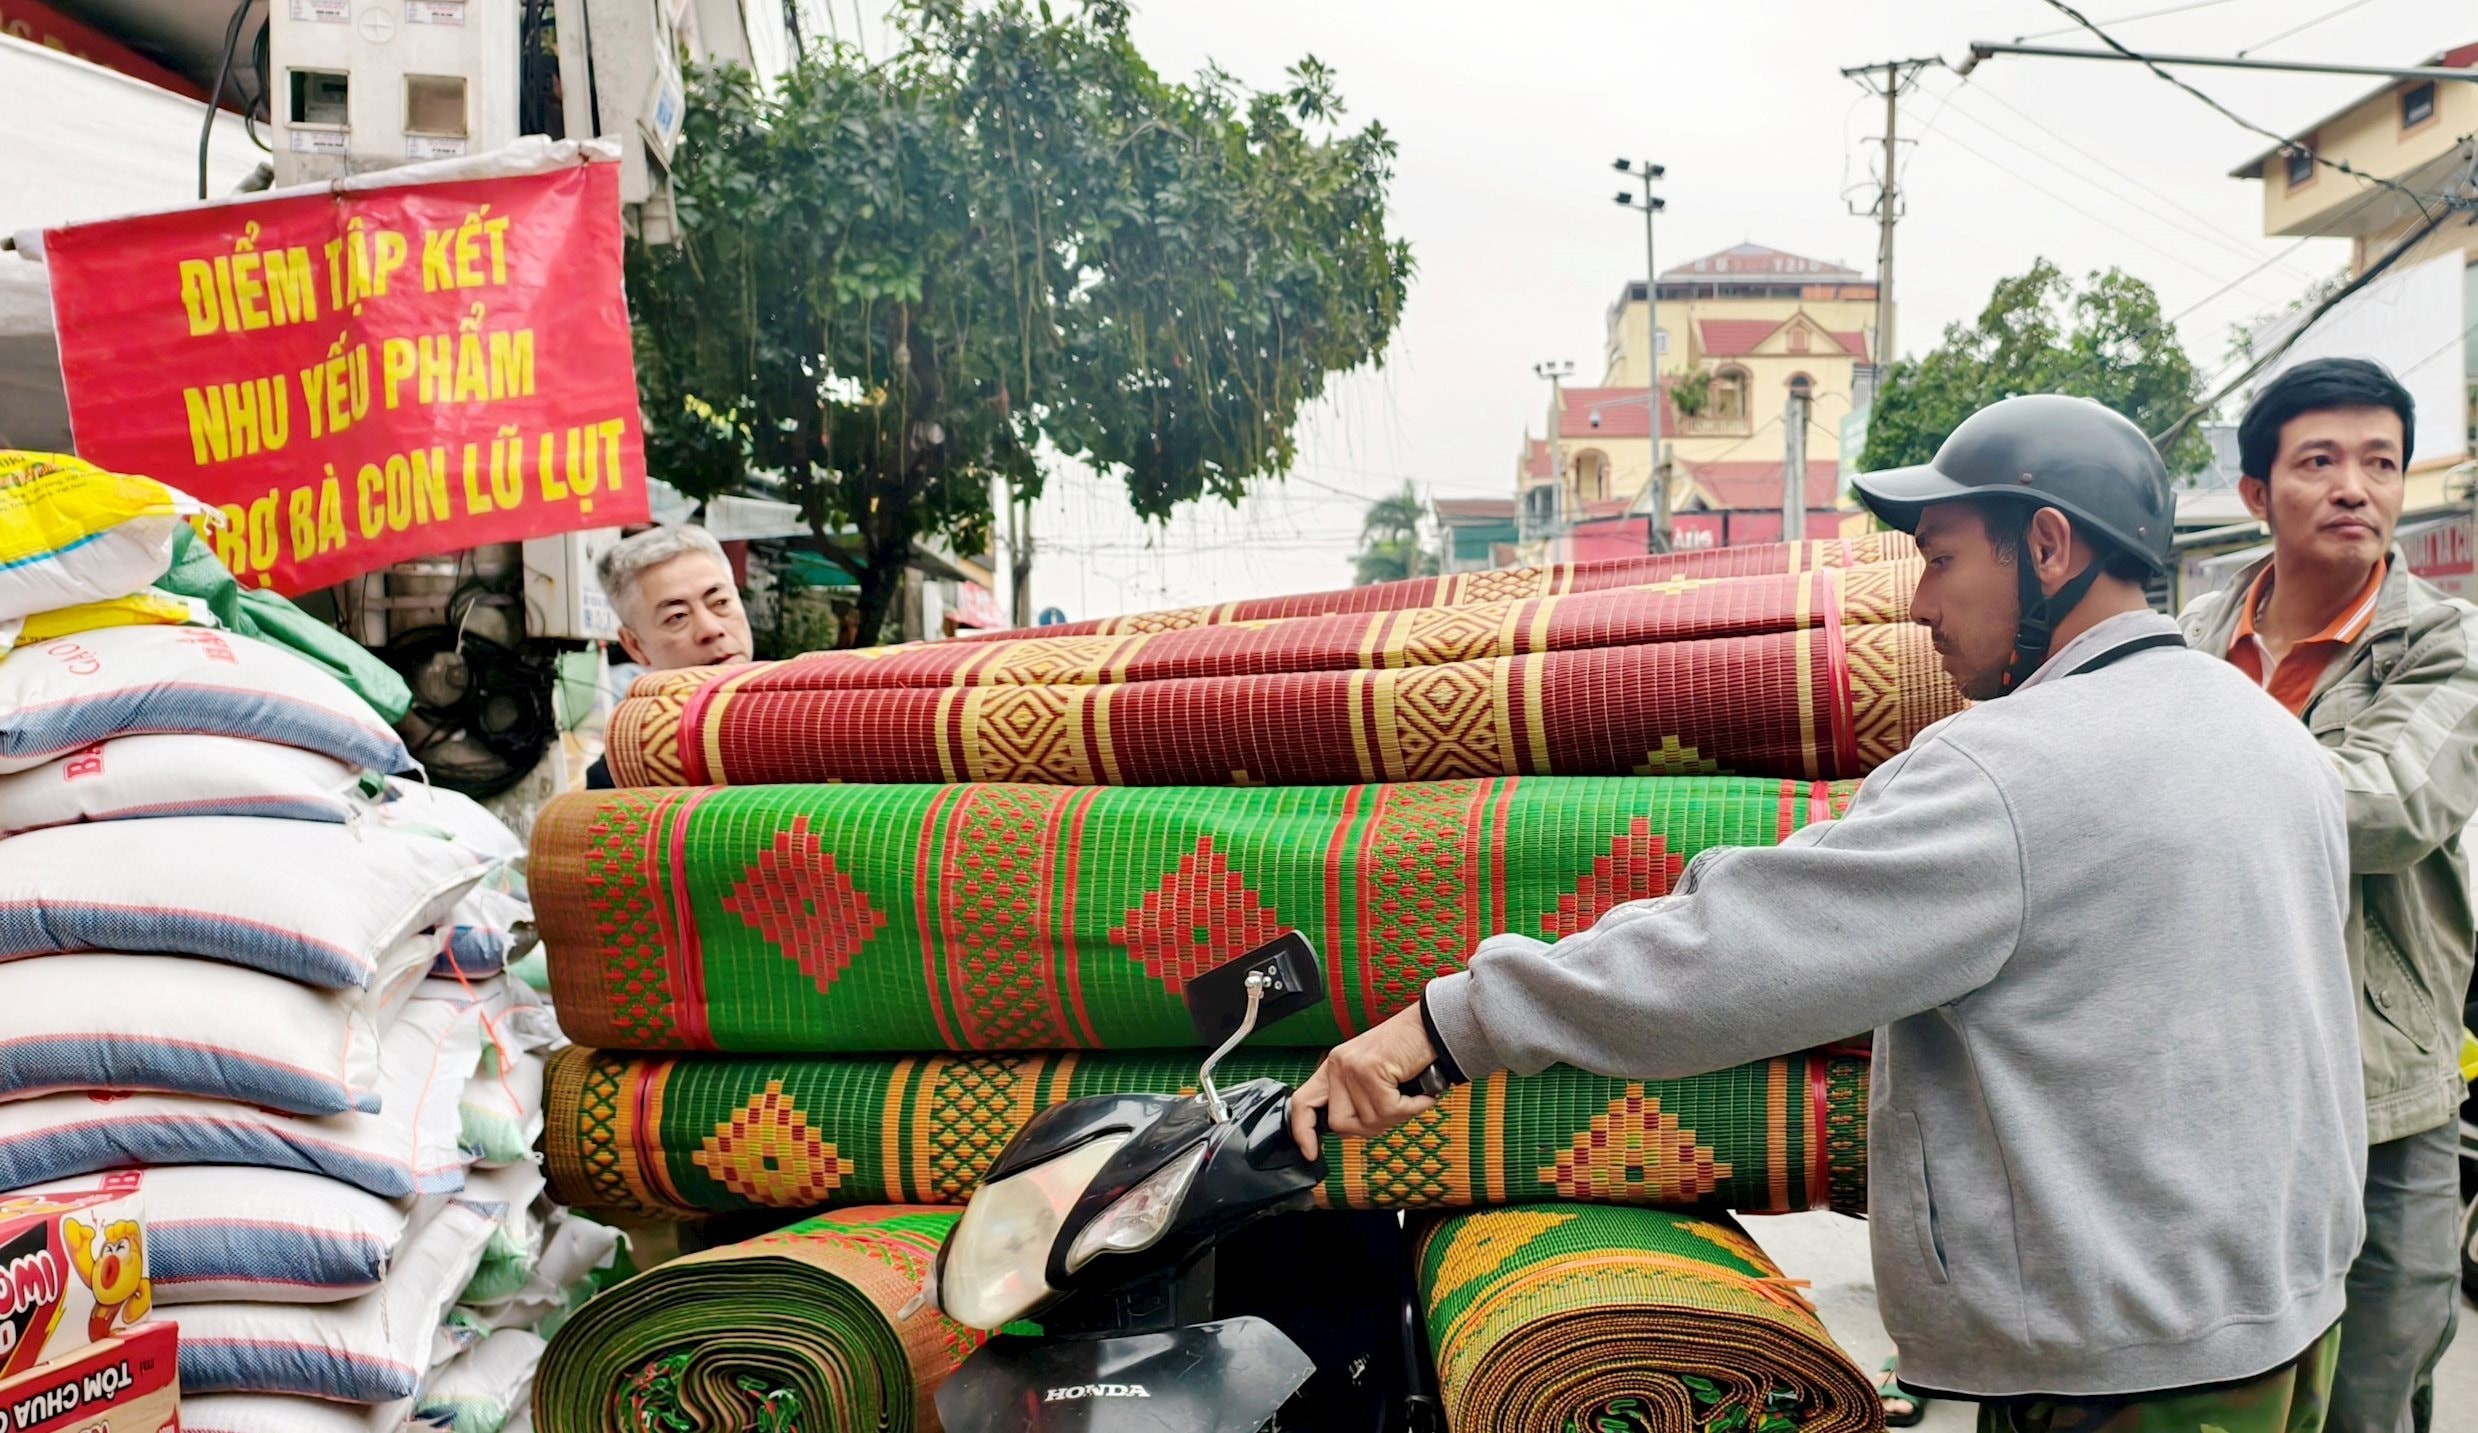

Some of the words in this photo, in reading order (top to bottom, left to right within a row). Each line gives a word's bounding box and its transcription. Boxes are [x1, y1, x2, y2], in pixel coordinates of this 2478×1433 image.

[179, 220, 317, 336] ĐIỂM
[324, 216, 408, 317] TẬP
[422, 203, 509, 293] KẾT
[183, 375, 288, 465] NHU
[300, 331, 369, 439] YẾU
[383, 302, 535, 409] PHẨM
[289, 463, 347, 564] BÀ
[356, 446, 451, 540] CON
[463, 424, 524, 516] LŨ
[540, 418, 625, 513] LỤT
[13, 1383, 79, 1429] CHUA
[83, 1361, 132, 1402] TÔM
[1044, 1384, 1151, 1402] HONDA
